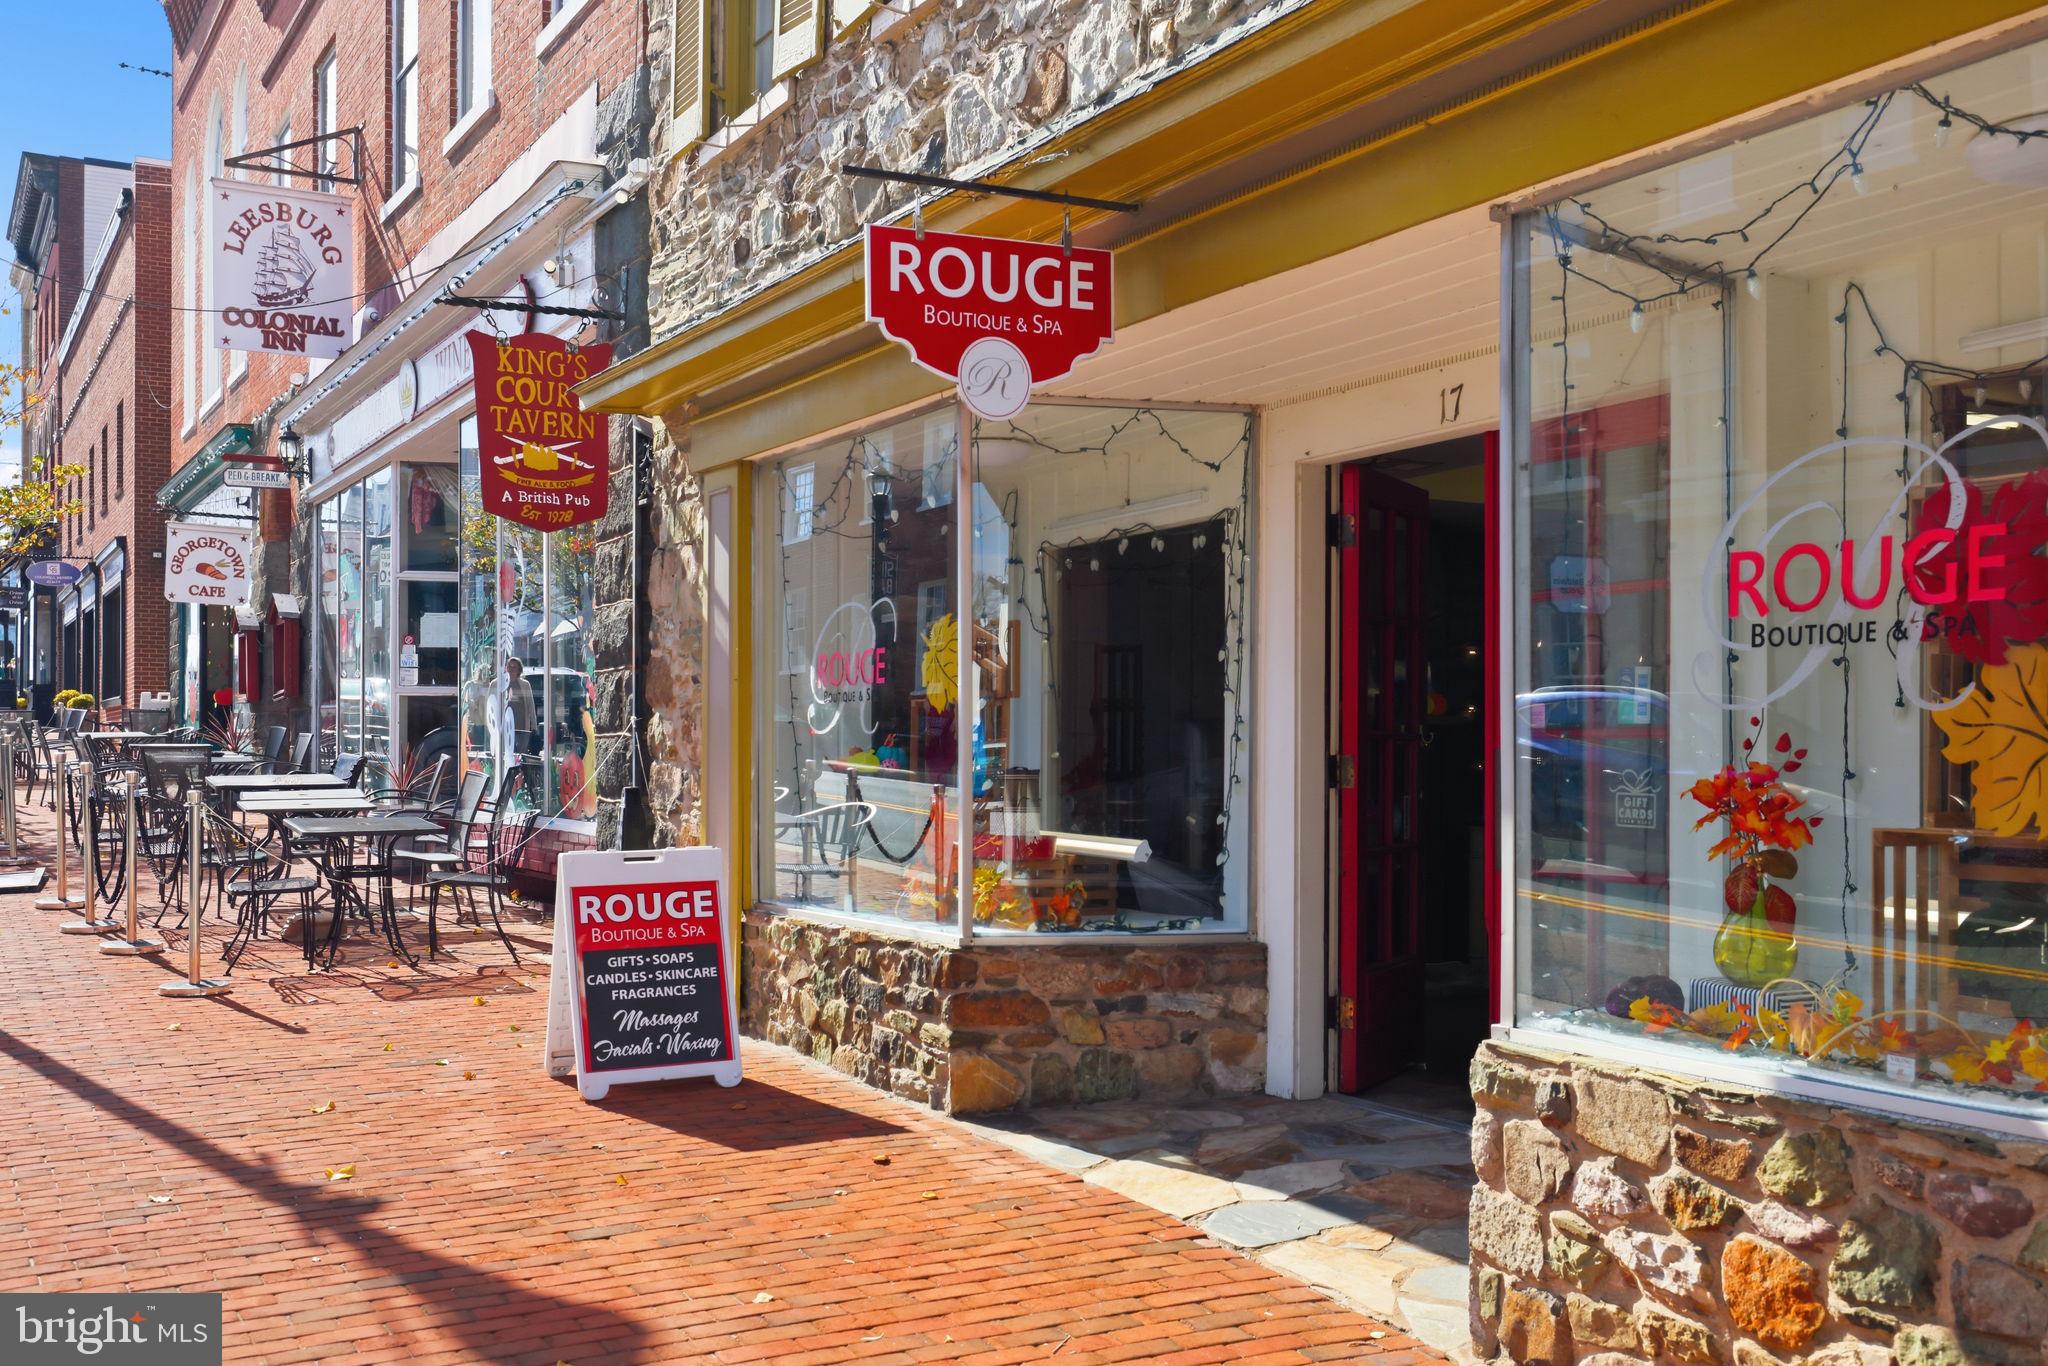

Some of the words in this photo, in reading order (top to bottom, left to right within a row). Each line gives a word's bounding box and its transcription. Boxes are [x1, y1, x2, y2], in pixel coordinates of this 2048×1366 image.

[223, 201, 343, 265] LEESBURG
[889, 241, 1094, 310] ROUGE
[222, 306, 345, 338] COLONIAL
[924, 304, 1011, 331] BOUTIQUE
[1017, 317, 1028, 332] &
[1032, 314, 1062, 336] SPA
[261, 329, 307, 352] INN
[497, 346, 588, 380] KING'S
[496, 375, 573, 408] COUR
[1440, 383, 1464, 424] 17
[490, 405, 595, 439] TAVERN
[501, 490, 513, 502] A
[518, 490, 560, 505] British
[565, 493, 591, 507] Pub
[548, 509, 575, 524] 1978
[170, 536, 245, 579] GEORGETOWN
[1728, 523, 2008, 619] ROUGE
[188, 584, 226, 598] CAFE
[1751, 620, 1877, 649] BOUTIQUE
[1892, 619, 1909, 643] &
[1925, 610, 1978, 640] SPA
[817, 647, 886, 689] ROUGE
[823, 690, 856, 704] BOUTQUE
[1618, 808, 1653, 820] CARDS
[578, 889, 714, 925] ROUGE
[591, 926, 663, 943] BOUTIQUE
[668, 927, 678, 938] &
[680, 922, 706, 939] SPA
[586, 971, 647, 986] CANDLES
[655, 966, 718, 982] SKINCARE
[611, 984, 697, 1001] FRAGRANCES
[613, 1009, 699, 1033] Massages
[594, 1035, 653, 1062] Facials
[659, 1032, 722, 1058] Waxing
